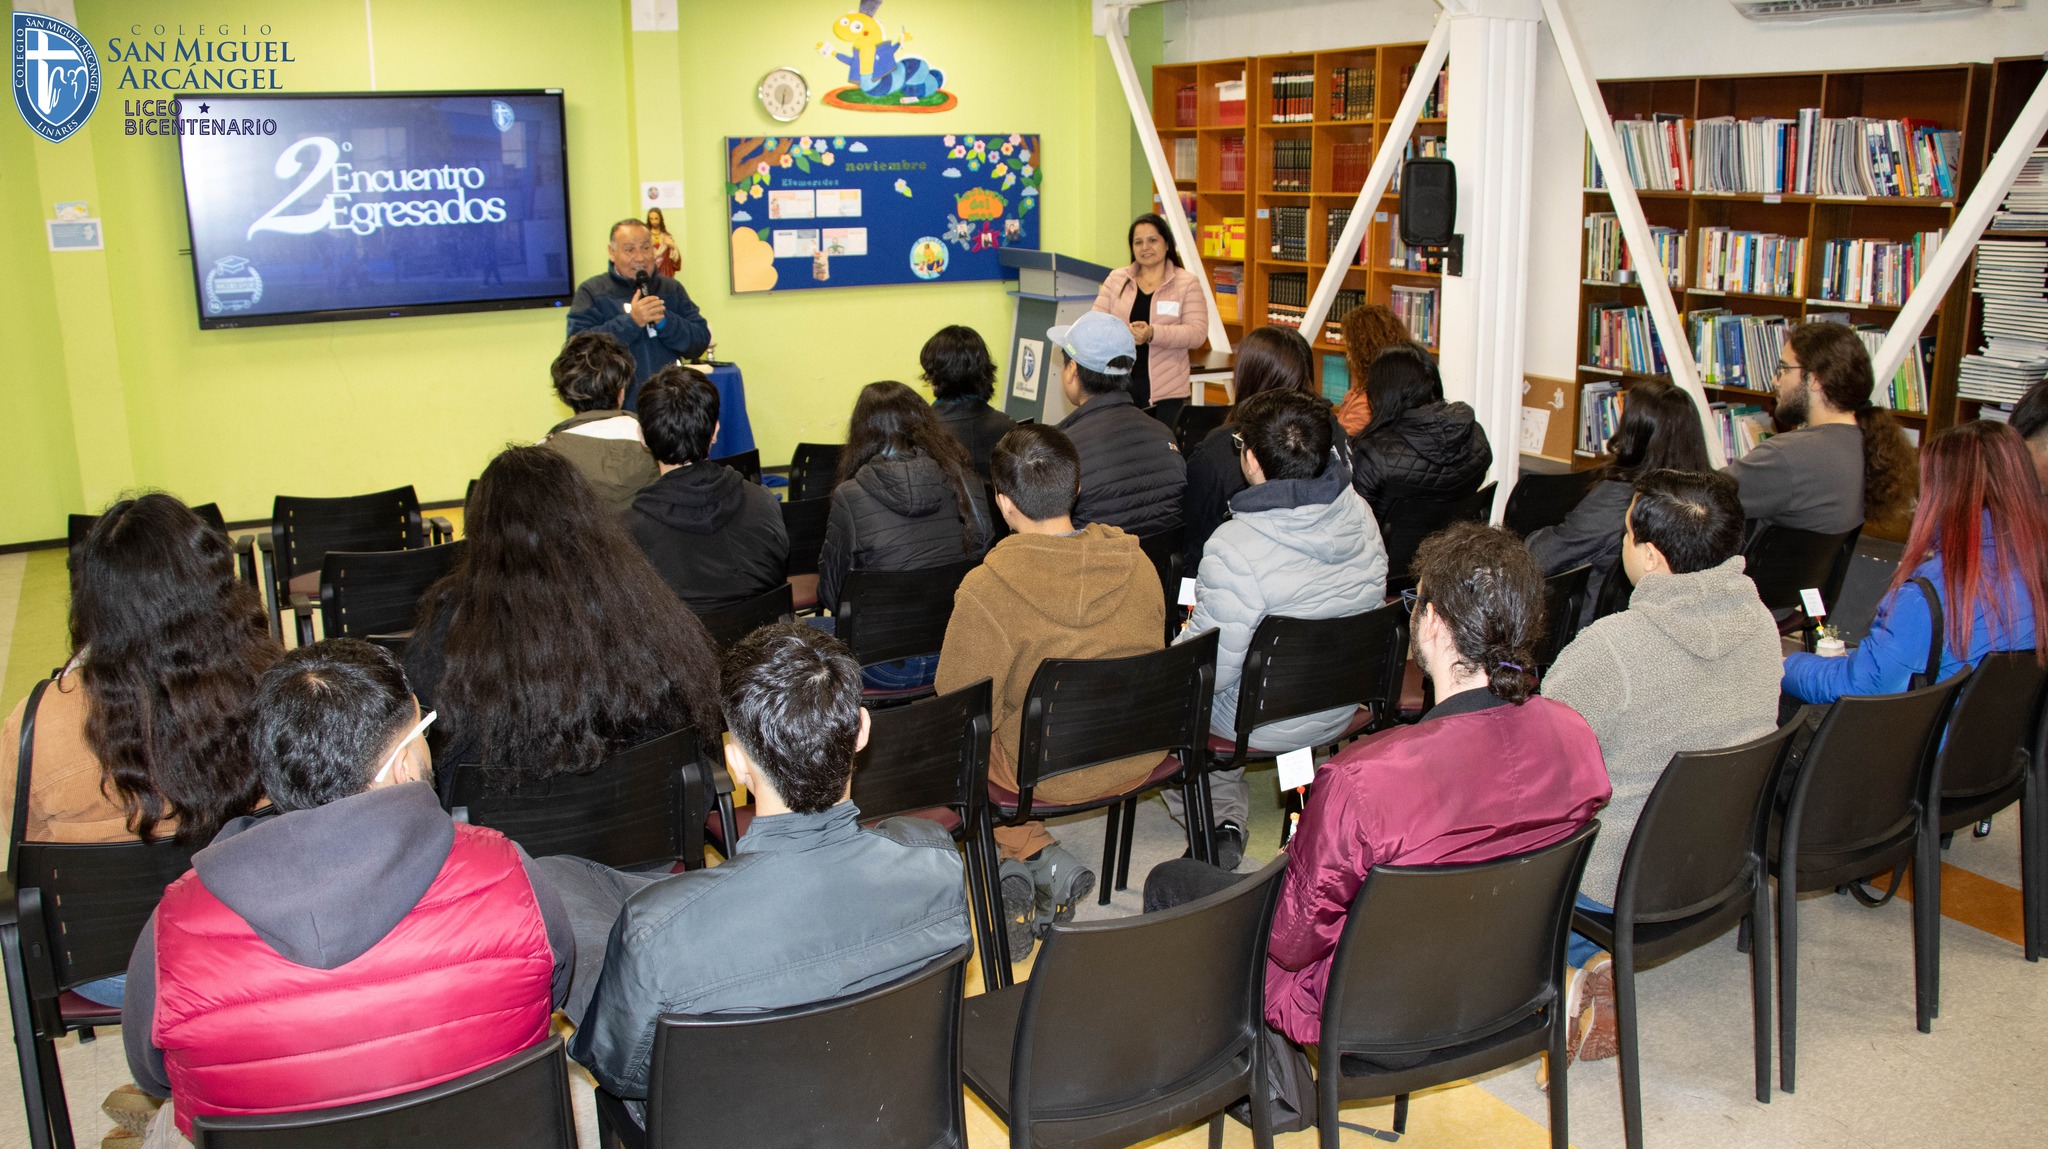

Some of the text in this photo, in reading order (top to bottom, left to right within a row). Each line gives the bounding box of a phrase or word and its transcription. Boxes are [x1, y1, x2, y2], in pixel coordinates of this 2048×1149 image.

[331, 162, 485, 193] Encuentro
[845, 160, 927, 172] noviembre
[326, 188, 507, 236] Egresados
